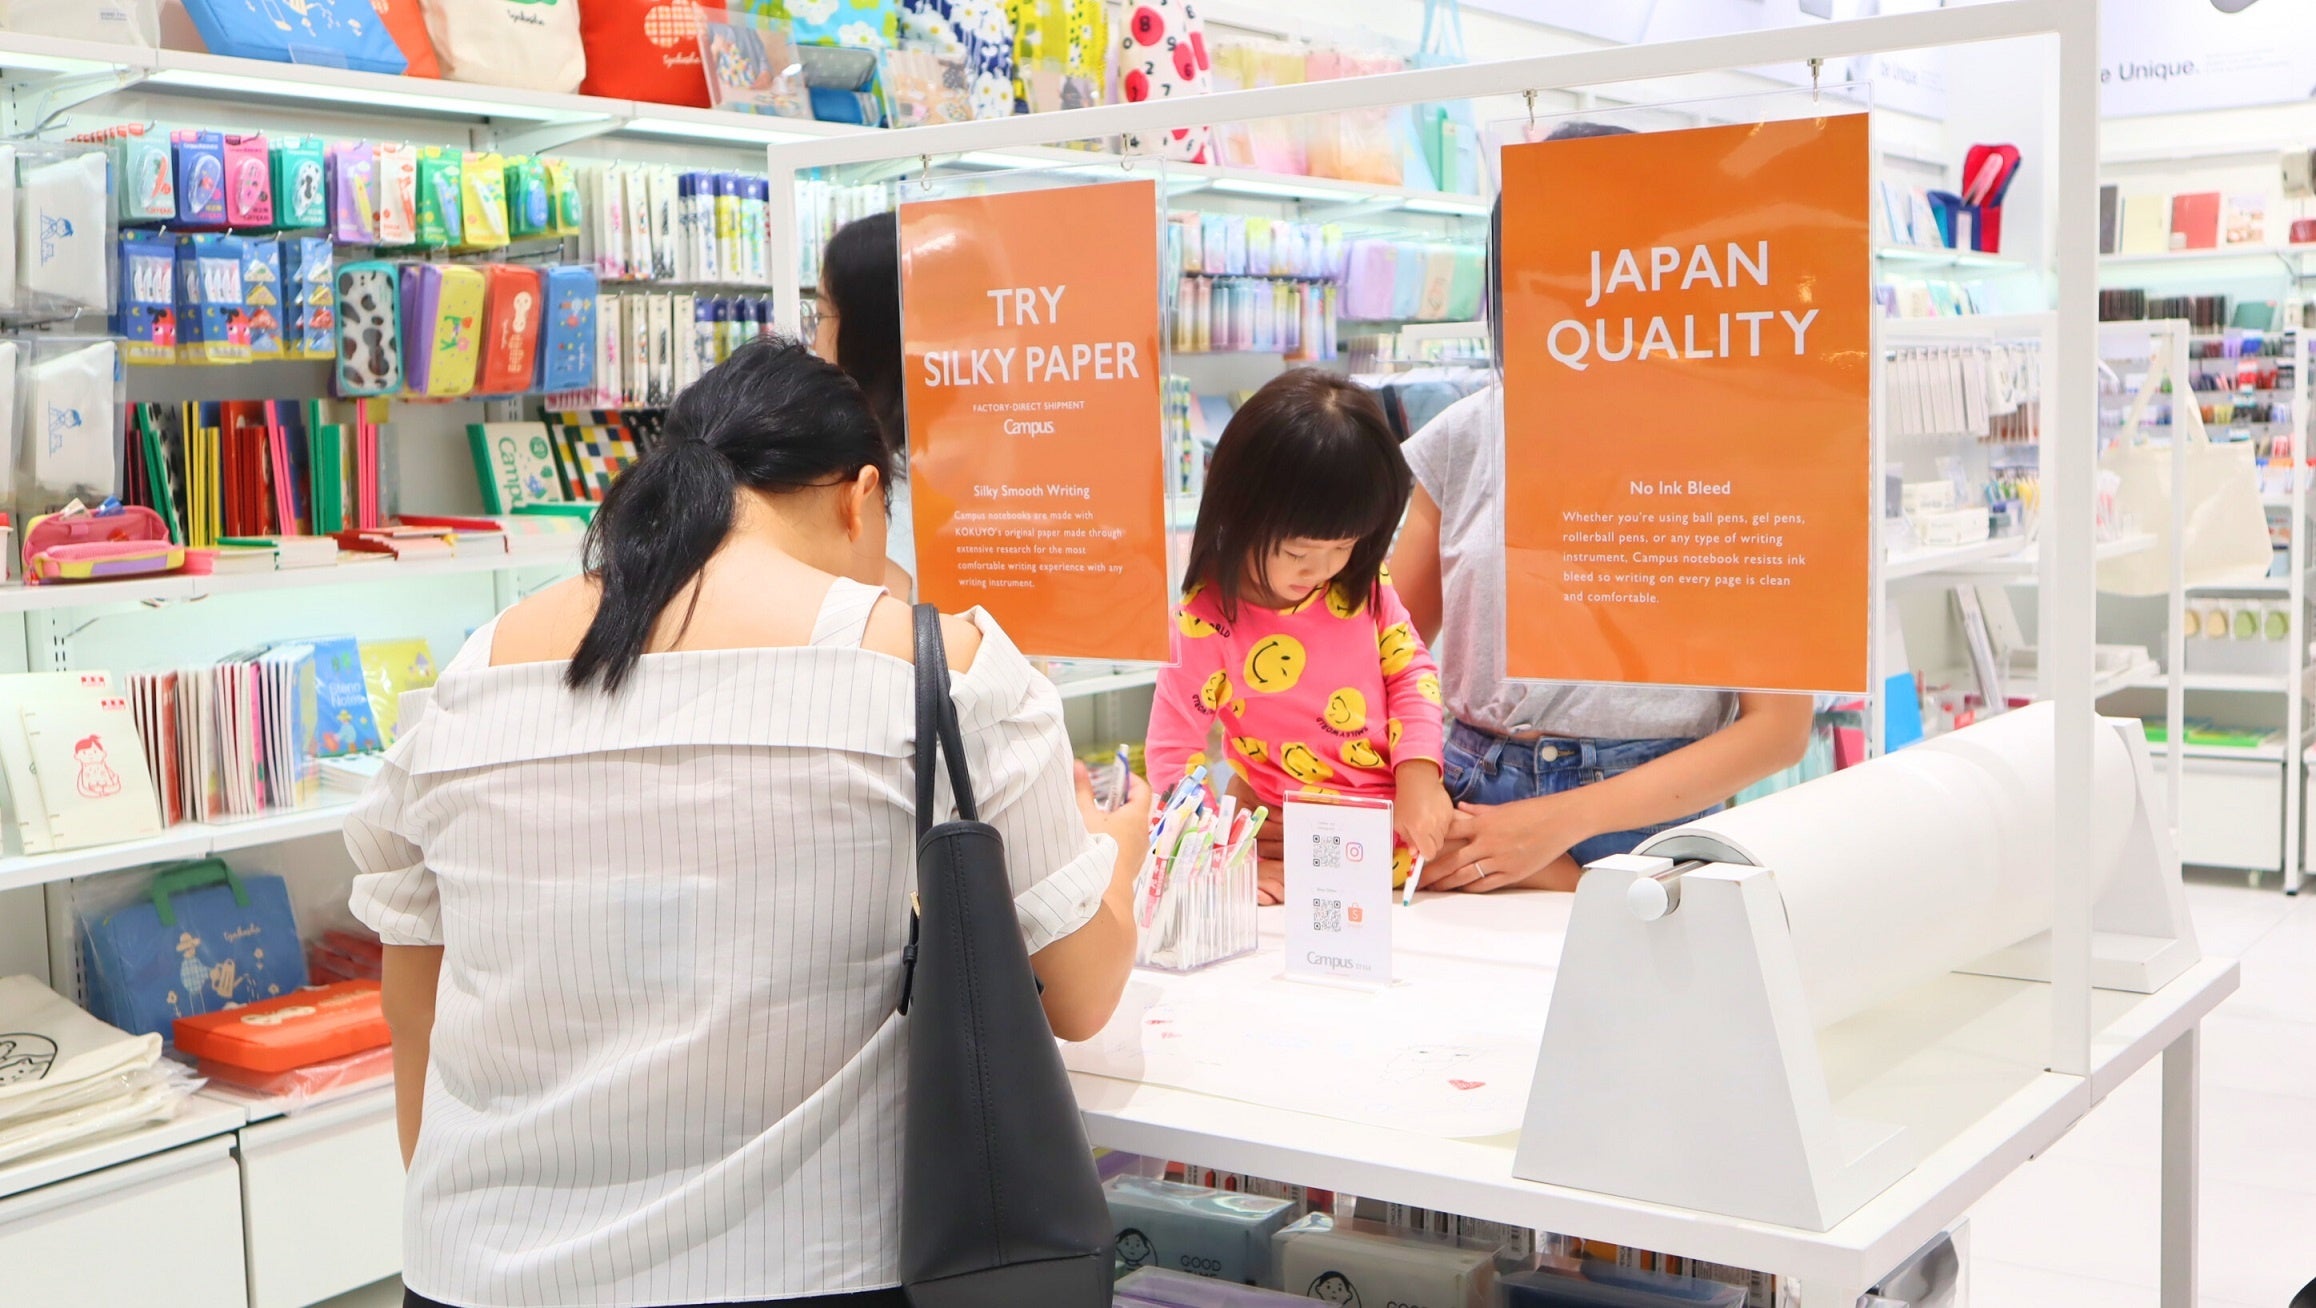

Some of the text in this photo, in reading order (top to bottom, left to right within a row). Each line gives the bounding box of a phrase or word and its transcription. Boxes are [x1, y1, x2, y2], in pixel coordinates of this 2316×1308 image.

[1145, 61, 1154, 75] 2
[2101, 68, 2111, 83] e
[2118, 59, 2200, 82] Unique.
[1161, 83, 1171, 96] 7
[1585, 241, 1768, 307] JAPAN
[987, 285, 1066, 326] TRY
[1547, 309, 1819, 371] QUALITY
[924, 342, 1139, 387] SILKY PAPER
[973, 401, 1085, 412] FACTORY-DIRECT SHIPMENT
[1004, 419, 1054, 437] Campus
[974, 485, 1090, 500] Silky Smooth Writing
[1630, 481, 1731, 495] No Ink Bleed
[954, 511, 985, 521] Campus
[989, 511, 1031, 520] notebooks
[1050, 512, 1071, 520] made
[1075, 511, 1093, 520] with
[1563, 512, 1805, 526] Whether you're using ball pens, gel pens,
[955, 527, 1122, 540] KOKUYO's original paper made through
[1563, 532, 1783, 546] rollerball pens, or any type of writing
[957, 545, 1086, 554] extensive research for the most
[1563, 552, 1806, 565] instrument, Campus notebook resists ink
[958, 561, 1123, 574] comfortable writing experience with any
[959, 577, 1035, 589] writing instrument.
[1563, 572, 1790, 587] bleed so writing on every page is clean
[1563, 591, 1659, 603] and comfortable.
[1306, 951, 1354, 970] Campus
[1180, 1254, 1222, 1272] GOOD
